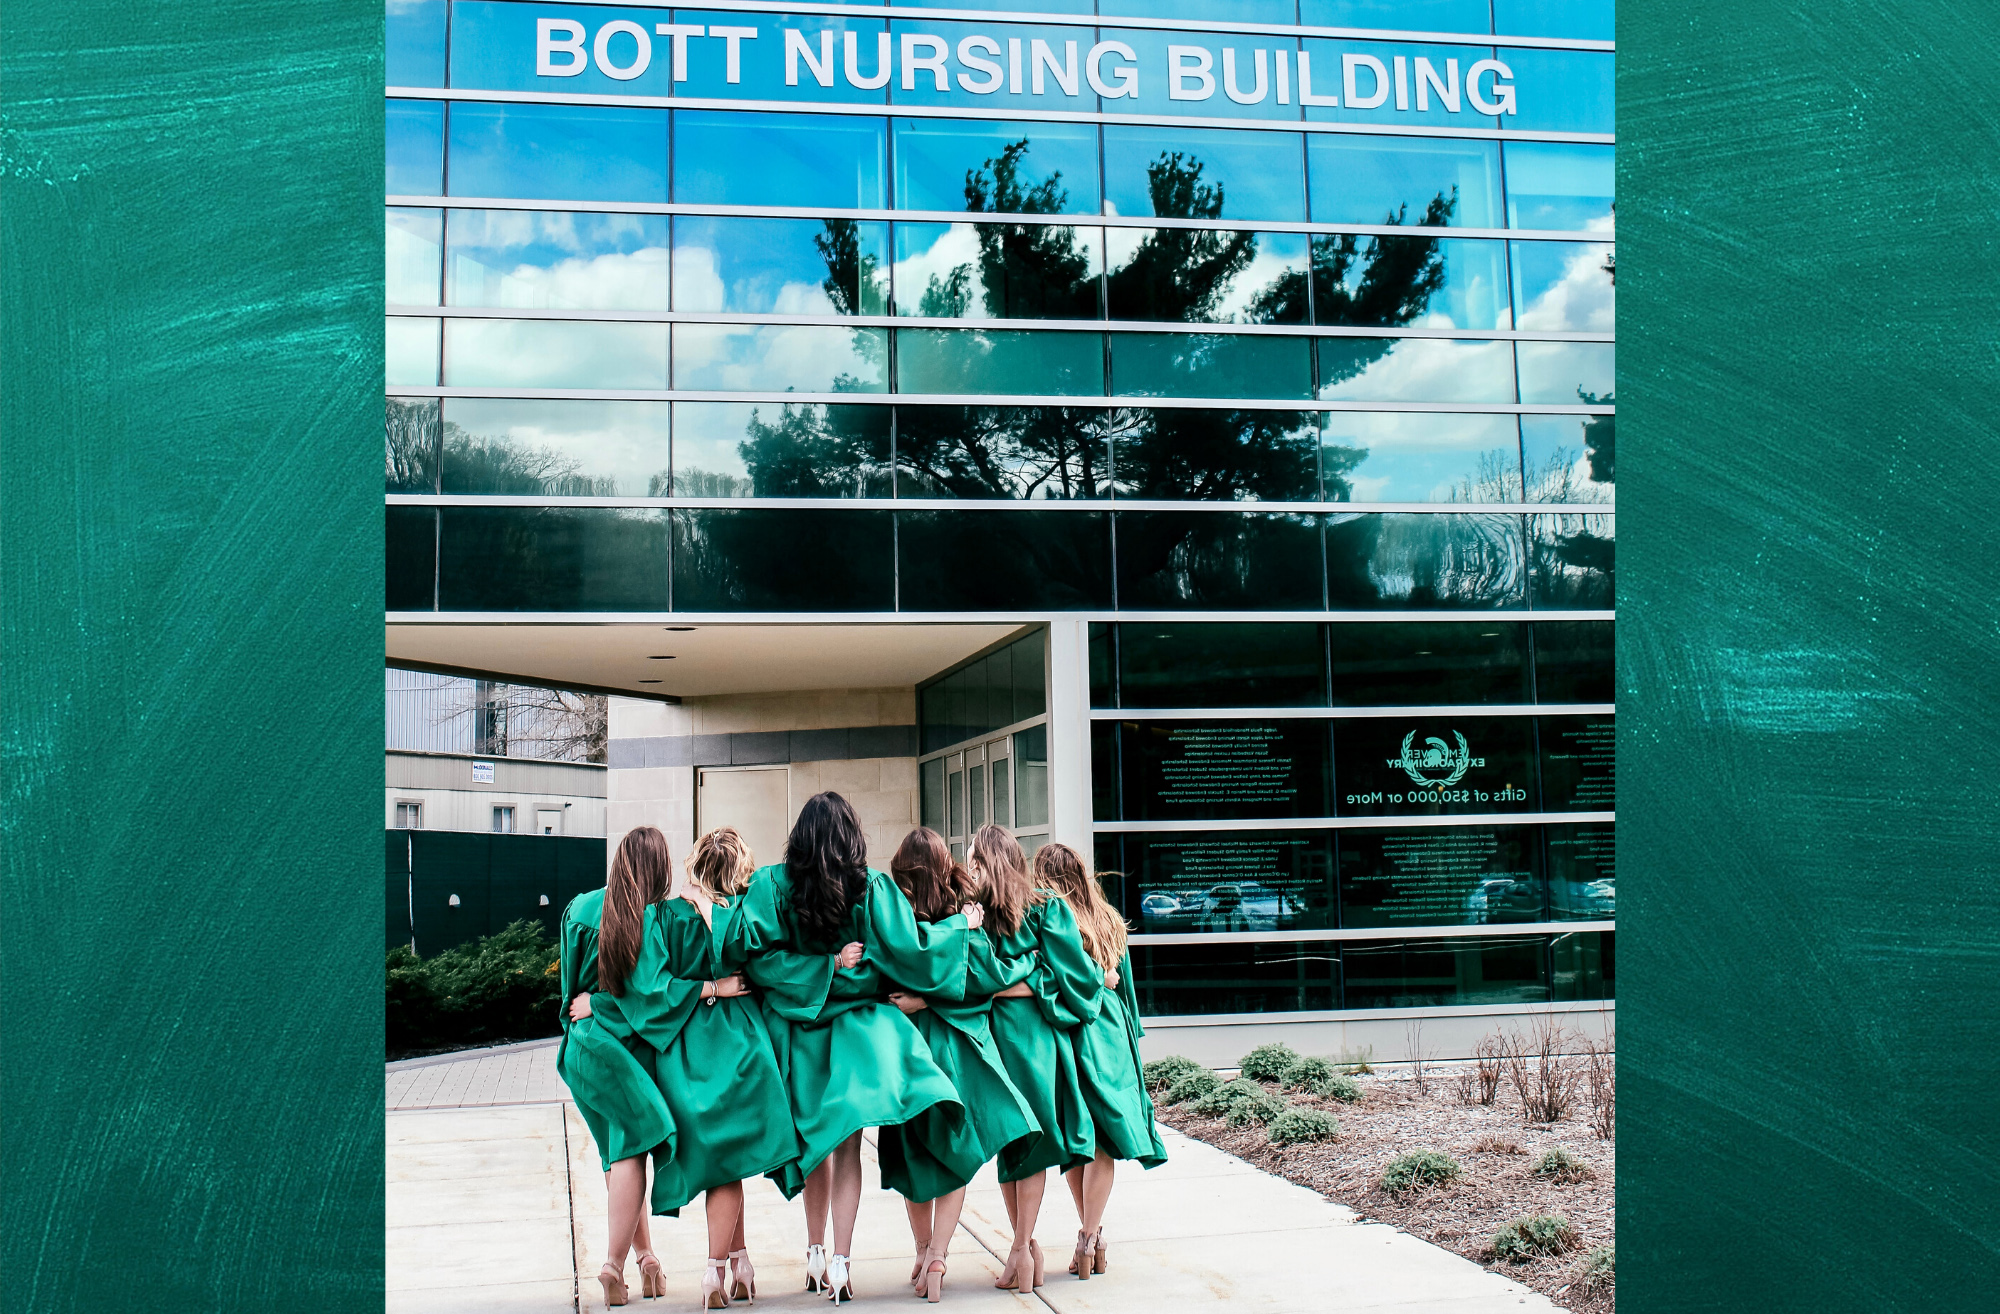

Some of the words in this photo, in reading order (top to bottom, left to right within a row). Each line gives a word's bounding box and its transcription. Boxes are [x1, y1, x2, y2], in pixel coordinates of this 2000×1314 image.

[536, 17, 758, 84] BOTT
[785, 28, 1139, 99] NURSING
[1167, 45, 1517, 116] BUILDING
